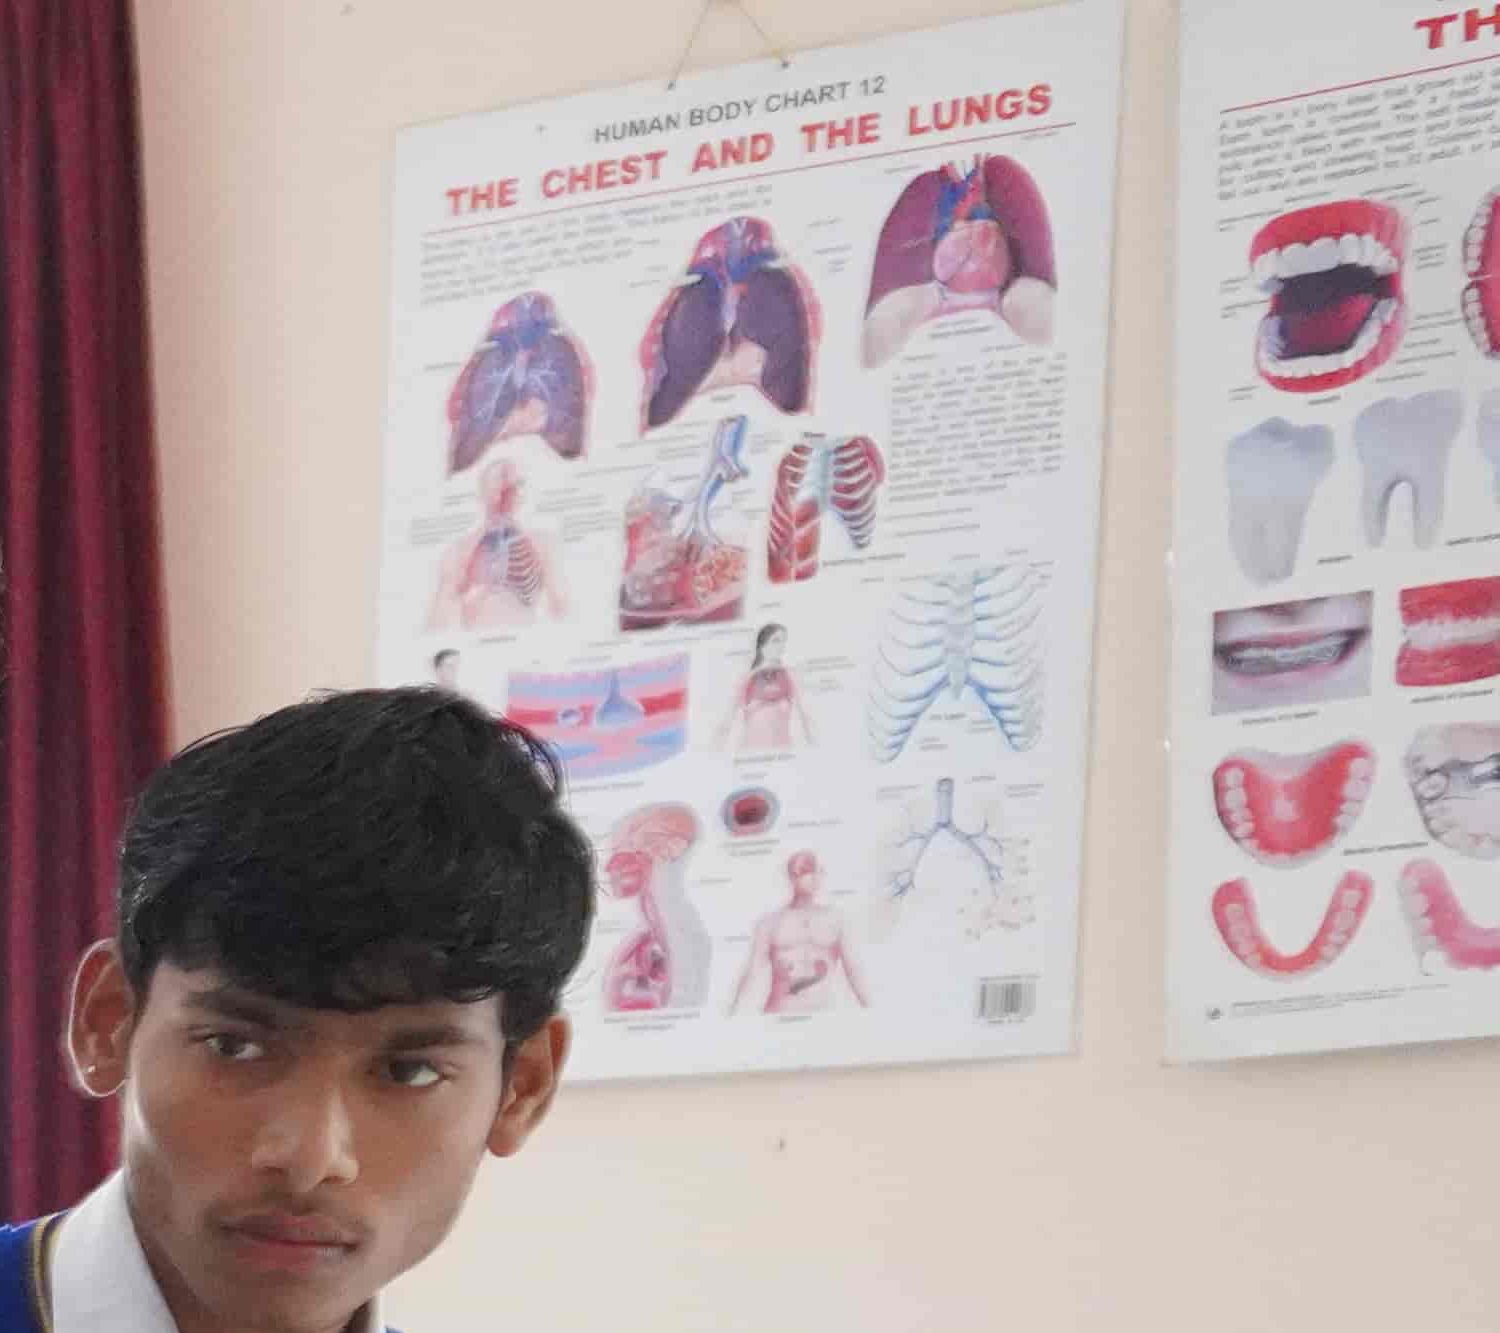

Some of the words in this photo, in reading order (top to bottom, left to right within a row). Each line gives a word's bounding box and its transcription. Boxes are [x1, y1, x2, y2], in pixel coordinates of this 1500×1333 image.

[1414, 4, 1500, 48] TH
[594, 111, 680, 143] HUMAN
[689, 99, 758, 129] BODY
[765, 81, 849, 114] CHART
[860, 75, 886, 97] 12
[446, 178, 519, 216] THE
[540, 151, 665, 200] CHEST
[691, 135, 775, 172] AND
[801, 113, 880, 152] THE
[908, 84, 1053, 136] LUNGS
